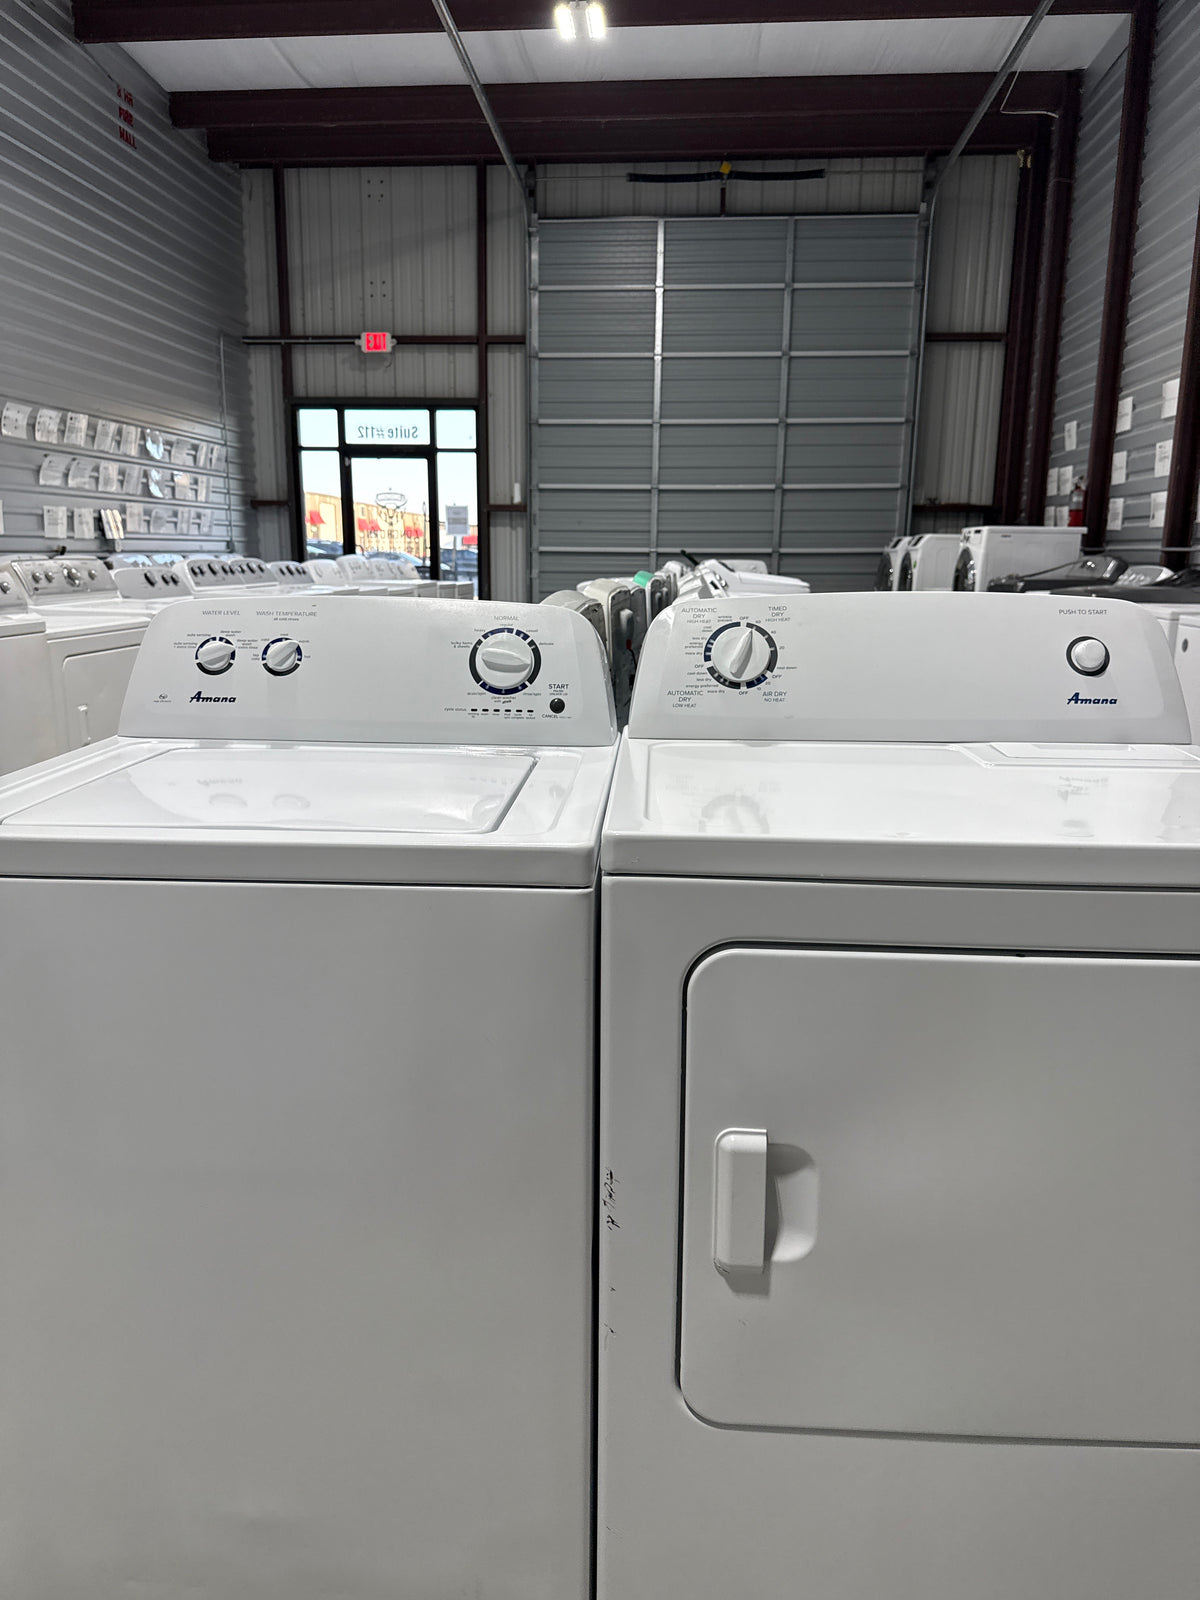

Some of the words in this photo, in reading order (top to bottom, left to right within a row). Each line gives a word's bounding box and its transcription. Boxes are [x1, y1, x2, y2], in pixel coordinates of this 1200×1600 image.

[118, 105, 134, 127] FIRE
[119, 126, 137, 150] WALL
[366, 332, 387, 352] EXIT
[189, 690, 237, 703] Amana
[1067, 692, 1118, 705] Amana
